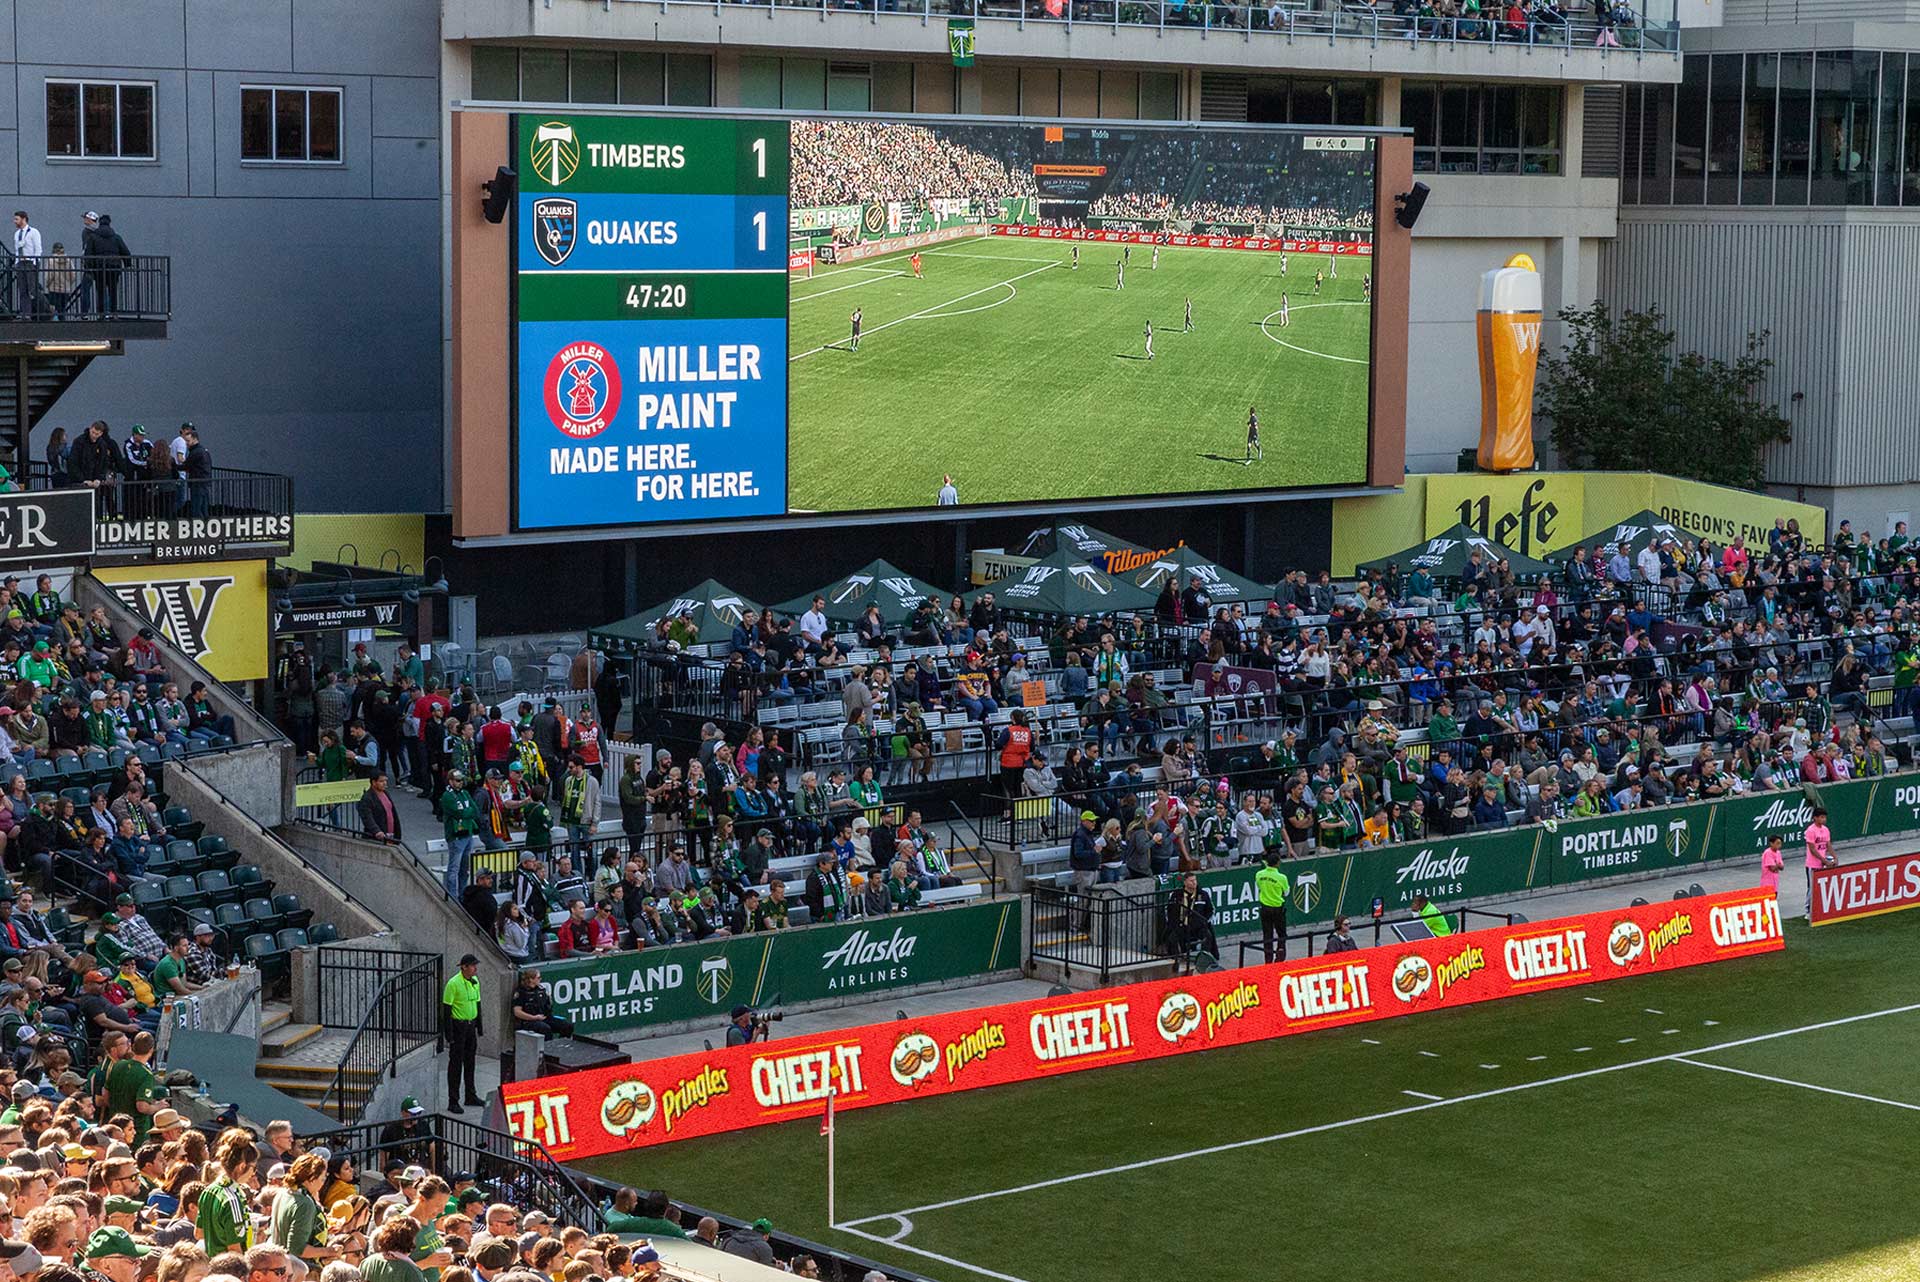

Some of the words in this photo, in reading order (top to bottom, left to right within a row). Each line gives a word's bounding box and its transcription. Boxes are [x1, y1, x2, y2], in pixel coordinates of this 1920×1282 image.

[587, 143, 685, 169] TIMBERS
[752, 138, 766, 178] 1
[538, 204, 573, 216] QUAKES
[587, 220, 678, 246] QUAKES
[752, 211, 767, 251] 1
[625, 284, 687, 308] 47:20
[560, 344, 604, 364] MILLER
[638, 344, 762, 384] MILLER
[562, 417, 606, 436] PAINTS
[638, 392, 738, 431] PAINT
[550, 446, 619, 475] MADE
[626, 443, 697, 471] HERE.
[636, 474, 684, 502] FOR
[691, 471, 760, 499] HERE.
[96, 521, 171, 544] IDMER
[178, 516, 291, 540] BROTHERS
[1661, 506, 1735, 538] OREGON'S
[157, 545, 217, 558] BREWING
[292, 611, 325, 622] WIDMER
[326, 609, 367, 620] BROTHERS
[1895, 785, 1920, 806] PO
[1753, 798, 1813, 831] Alaska
[1562, 823, 1658, 857] PORTLAND
[1756, 831, 1806, 847] AIINE
[1396, 847, 1470, 884] Alaska
[1583, 850, 1639, 870] TIMBERS
[1818, 859, 1920, 914] WELLS
[1210, 906, 1260, 925] MBERS
[822, 926, 917, 970] Alaska
[1648, 911, 1693, 966] Pringles
[828, 967, 908, 990] AIRLINES
[1436, 943, 1486, 1000] Pringles
[568, 998, 655, 1023] TIMBERS
[1206, 981, 1260, 1039] Pringles
[945, 1020, 1006, 1084] Pringles
[662, 1064, 729, 1132] Pringles
